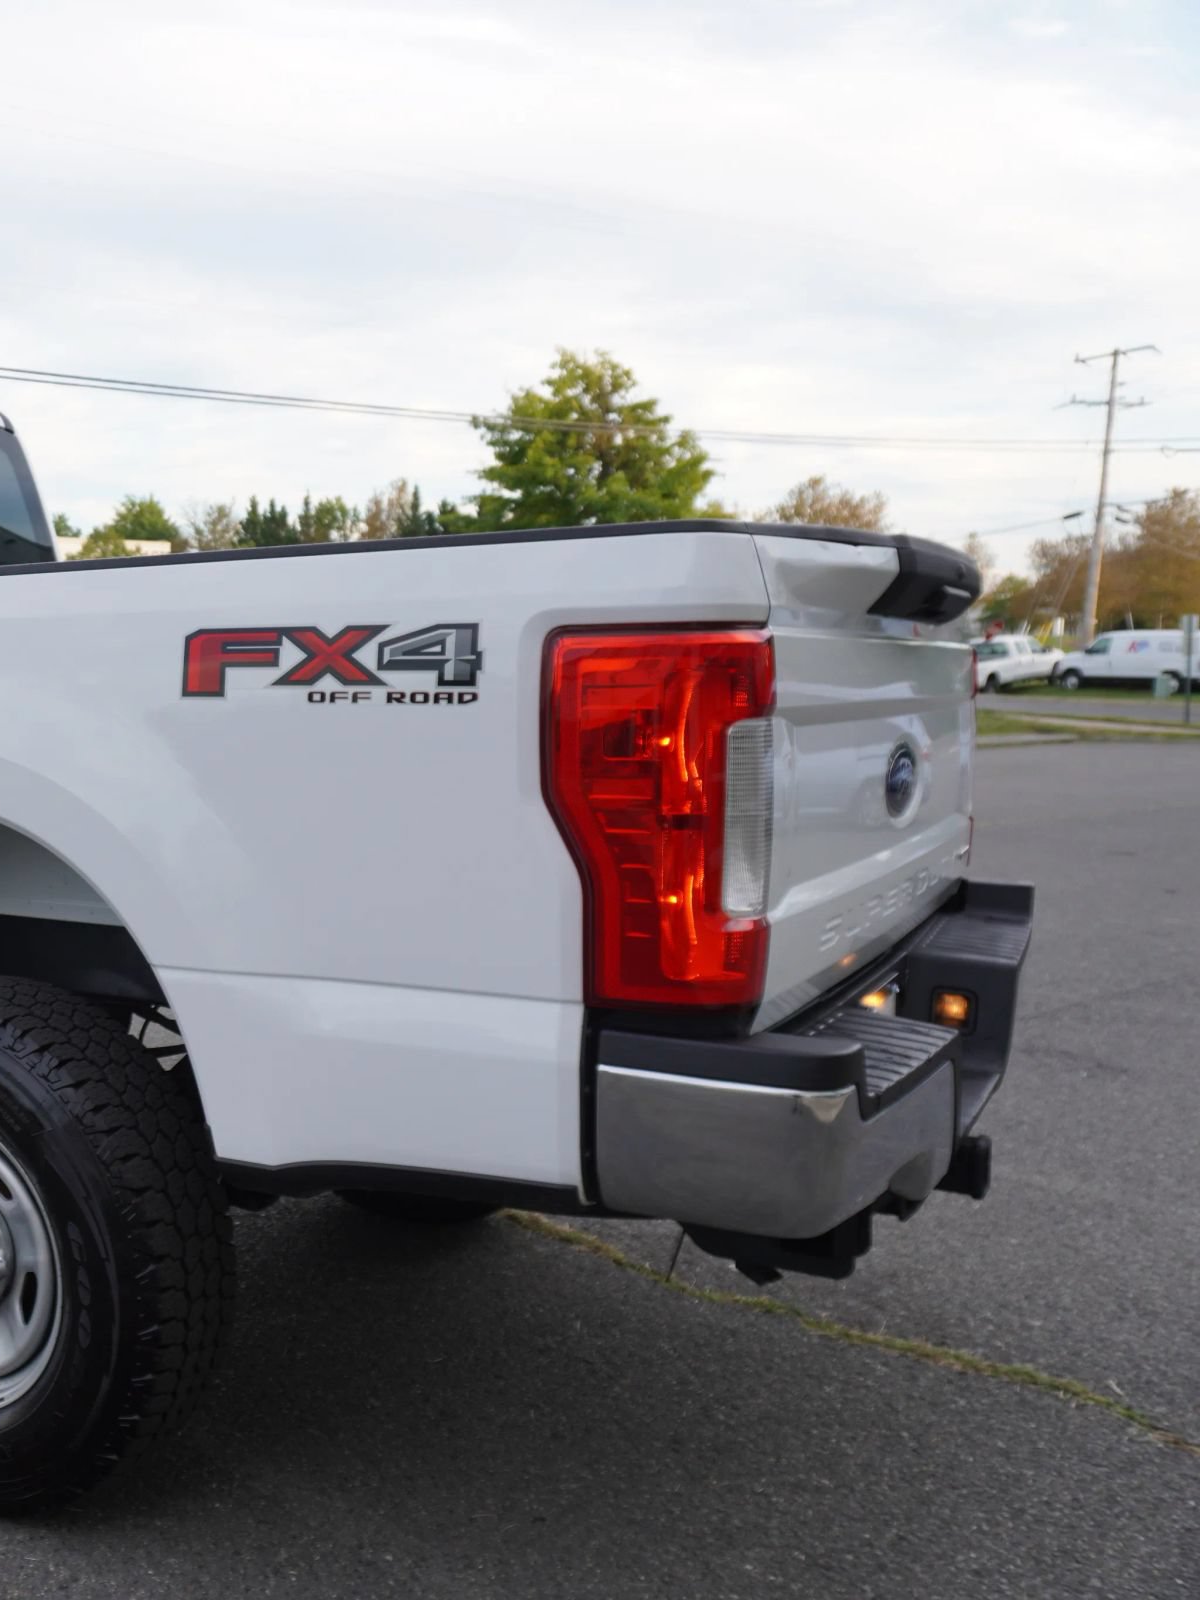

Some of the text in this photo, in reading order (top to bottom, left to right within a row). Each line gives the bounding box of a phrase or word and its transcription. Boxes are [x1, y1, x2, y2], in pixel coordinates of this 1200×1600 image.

[182, 623, 482, 697] FX4
[307, 691, 479, 705] OFF ROAD
